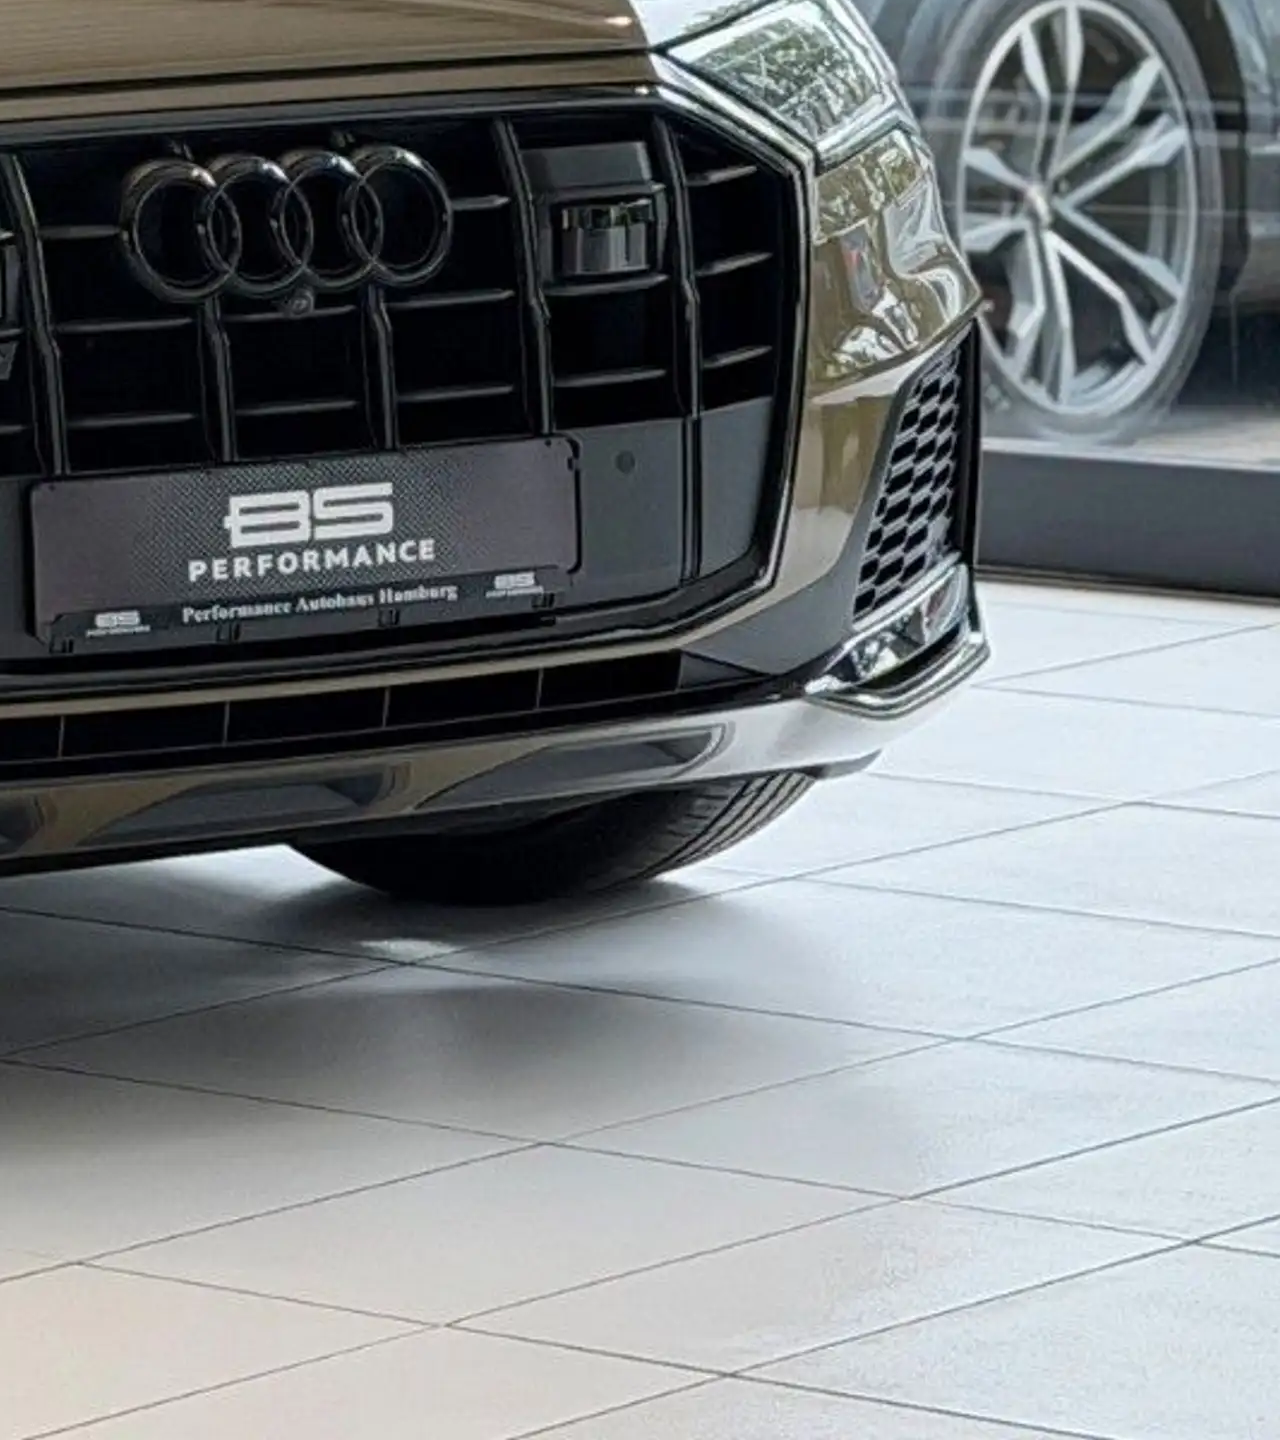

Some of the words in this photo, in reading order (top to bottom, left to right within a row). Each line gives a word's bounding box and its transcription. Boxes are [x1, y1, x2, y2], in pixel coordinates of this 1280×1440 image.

[224, 482, 394, 548] BS
[188, 538, 437, 582] PERFORMANCE
[182, 602, 292, 625] Performance
[295, 592, 375, 613] Autohaus
[378, 584, 458, 605] Hamburg
